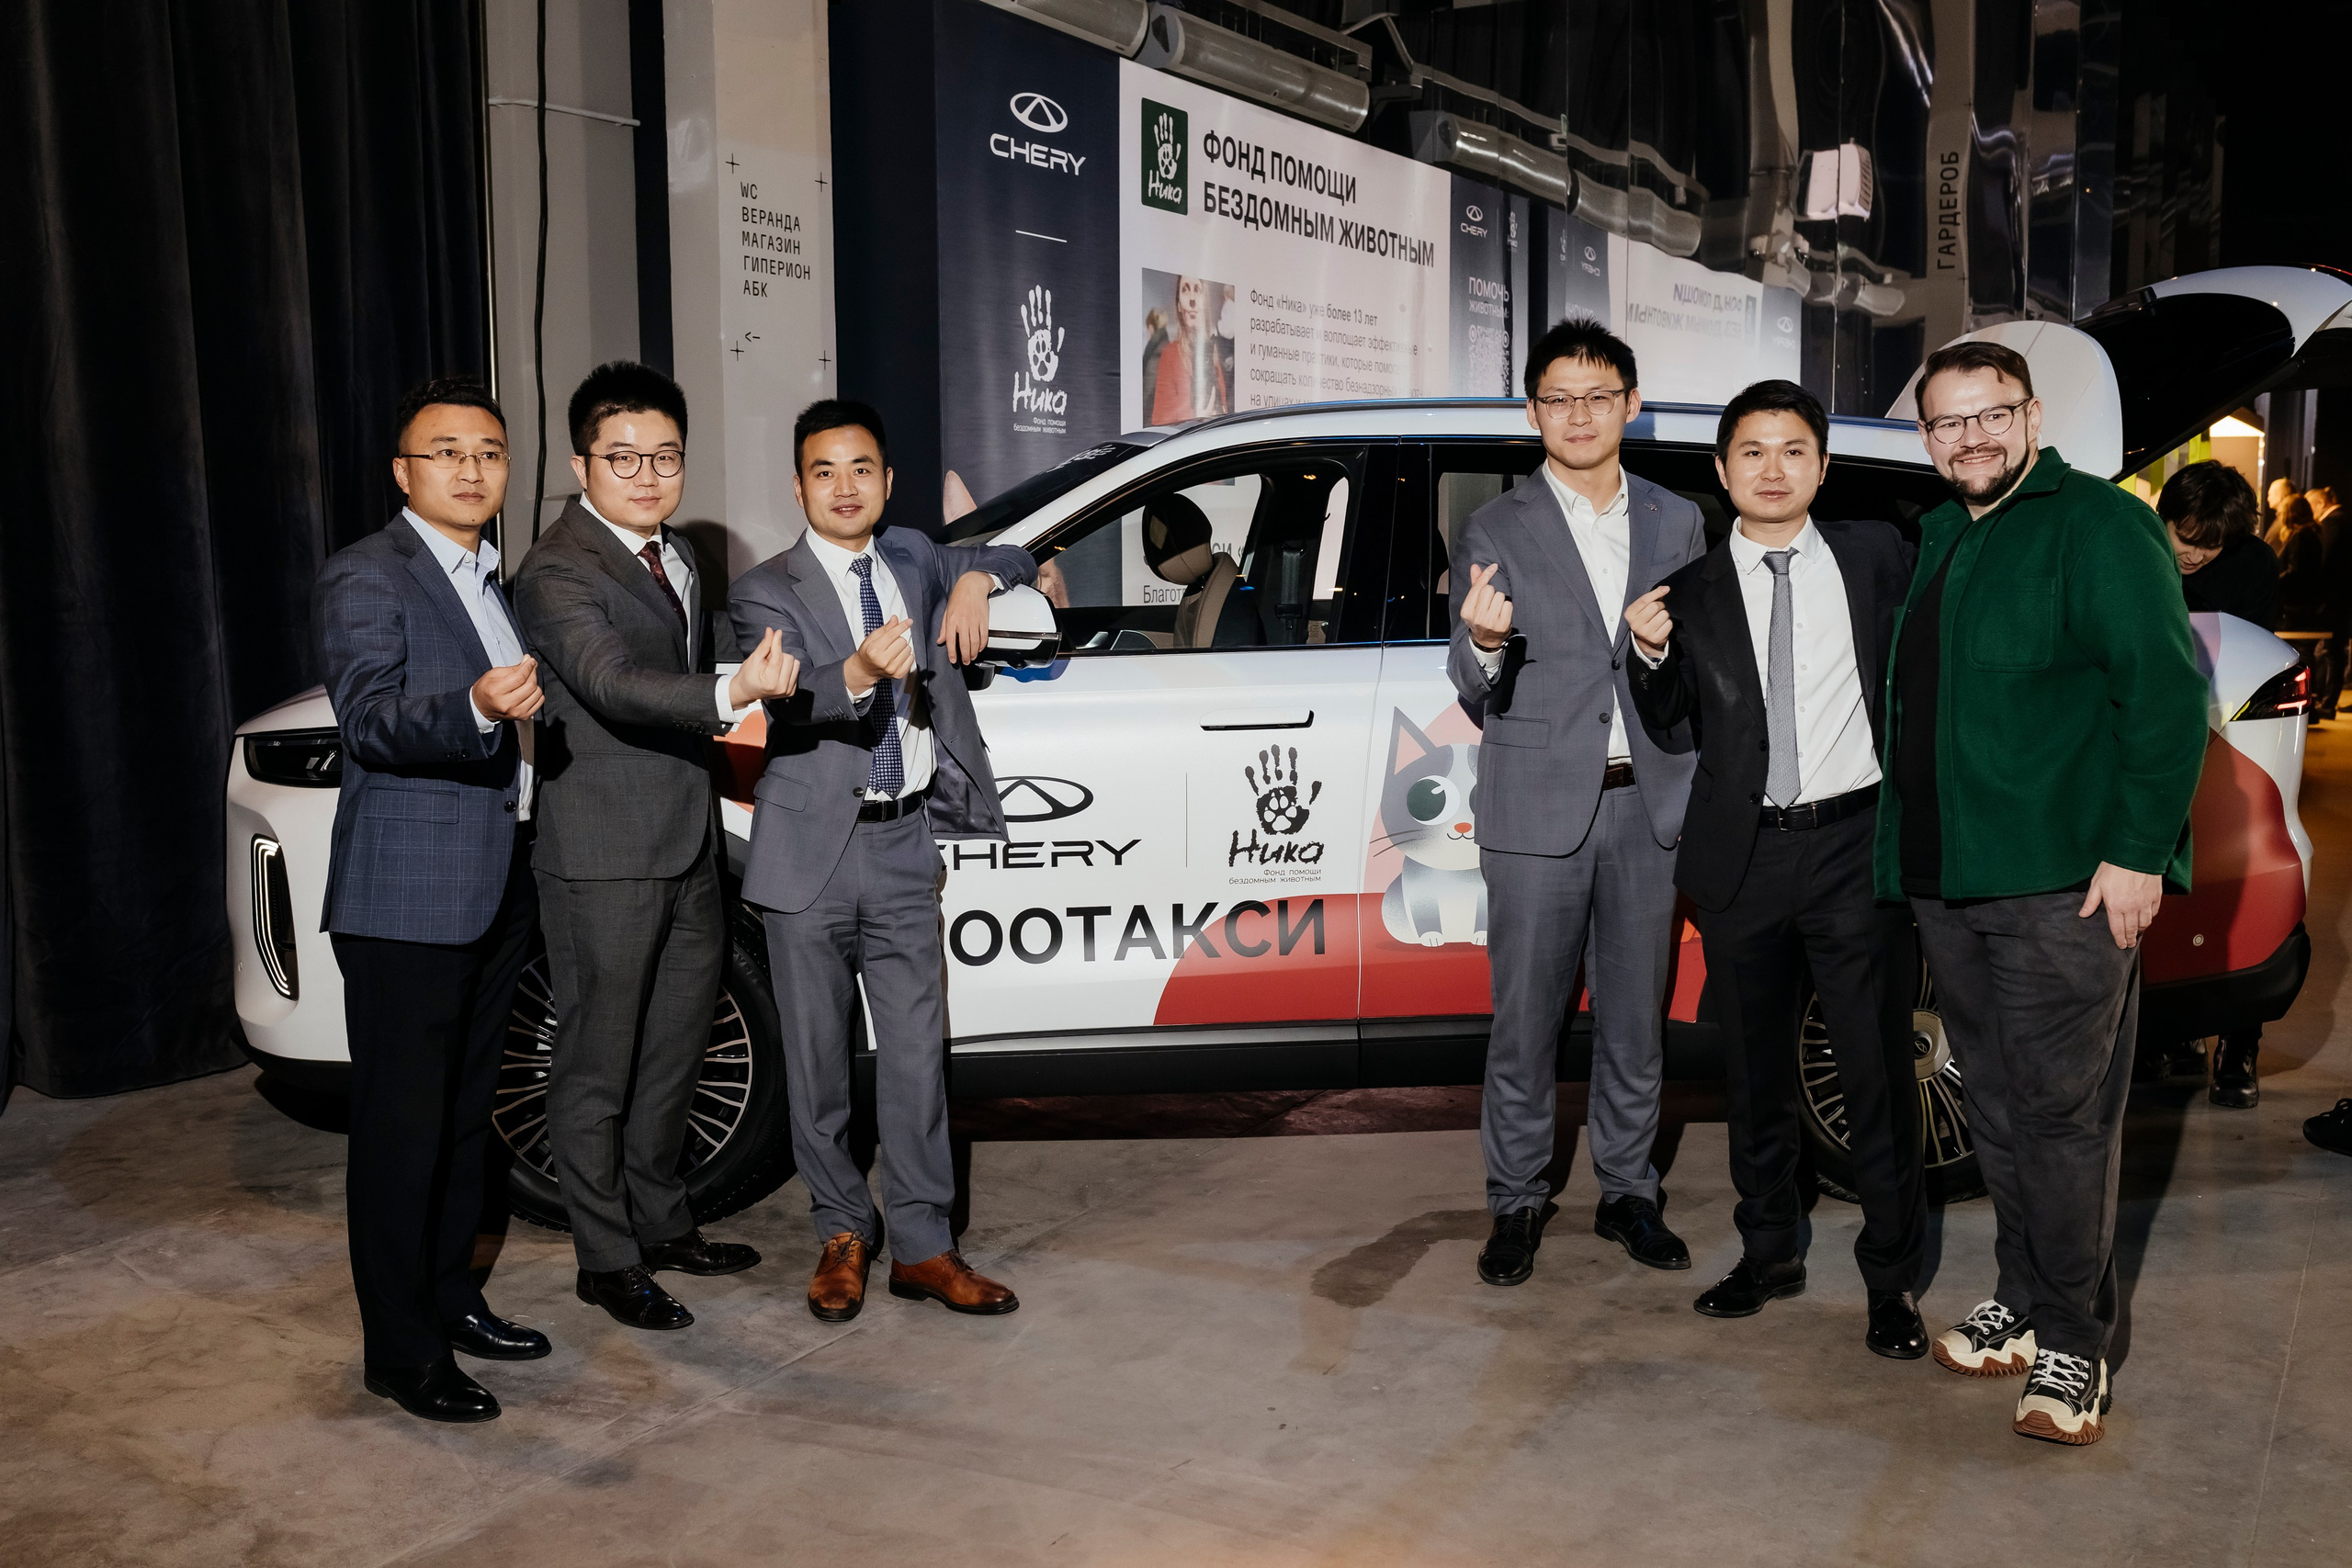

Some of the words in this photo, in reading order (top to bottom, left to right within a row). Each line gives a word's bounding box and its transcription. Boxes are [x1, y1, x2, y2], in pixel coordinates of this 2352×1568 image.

[989, 132, 1087, 176] CHERY
[1203, 130, 1266, 184] ФОНД
[1271, 151, 1357, 206] ПОМОЩИ
[740, 181, 758, 199] WC
[1148, 169, 1182, 204] Ника
[741, 206, 801, 233] ВЕРАНДА
[1204, 181, 1335, 243] БЕЗДОМНЫМ
[1338, 218, 1434, 268] ЖИВОТНЫМ
[1937, 151, 1962, 270] ГАРДЕРОБ
[741, 231, 801, 255] МАГАЗИН
[1460, 222, 1488, 239] CHERY
[743, 255, 810, 280] ГИПЕРИОН
[743, 279, 768, 298] АБК
[1468, 276, 1510, 302] ПОМОЧЬ
[1250, 288, 1274, 310] Фонд
[1276, 294, 1307, 313] «Ника»
[1327, 303, 1351, 322] более
[1353, 309, 1363, 324] 13
[1364, 313, 1378, 326] лет
[1250, 318, 1315, 340] разрабатывает
[1324, 330, 1366, 348] воплощает
[1368, 334, 1418, 355] эффекте
[1250, 343, 1256, 355] и
[1259, 344, 1300, 361] гуманные
[1302, 350, 1340, 369] пратики,
[1341, 356, 1373, 373] которые
[1012, 371, 1068, 415] Ника
[1250, 368, 1296, 386] сокращать
[1298, 375, 1343, 391] колество
[1250, 393, 1261, 406] на
[938, 839, 1143, 871] HERY
[1228, 829, 1325, 867] Ника
[1228, 876, 1276, 885] бездомным
[938, 898, 1326, 966] ООТАКСИ
